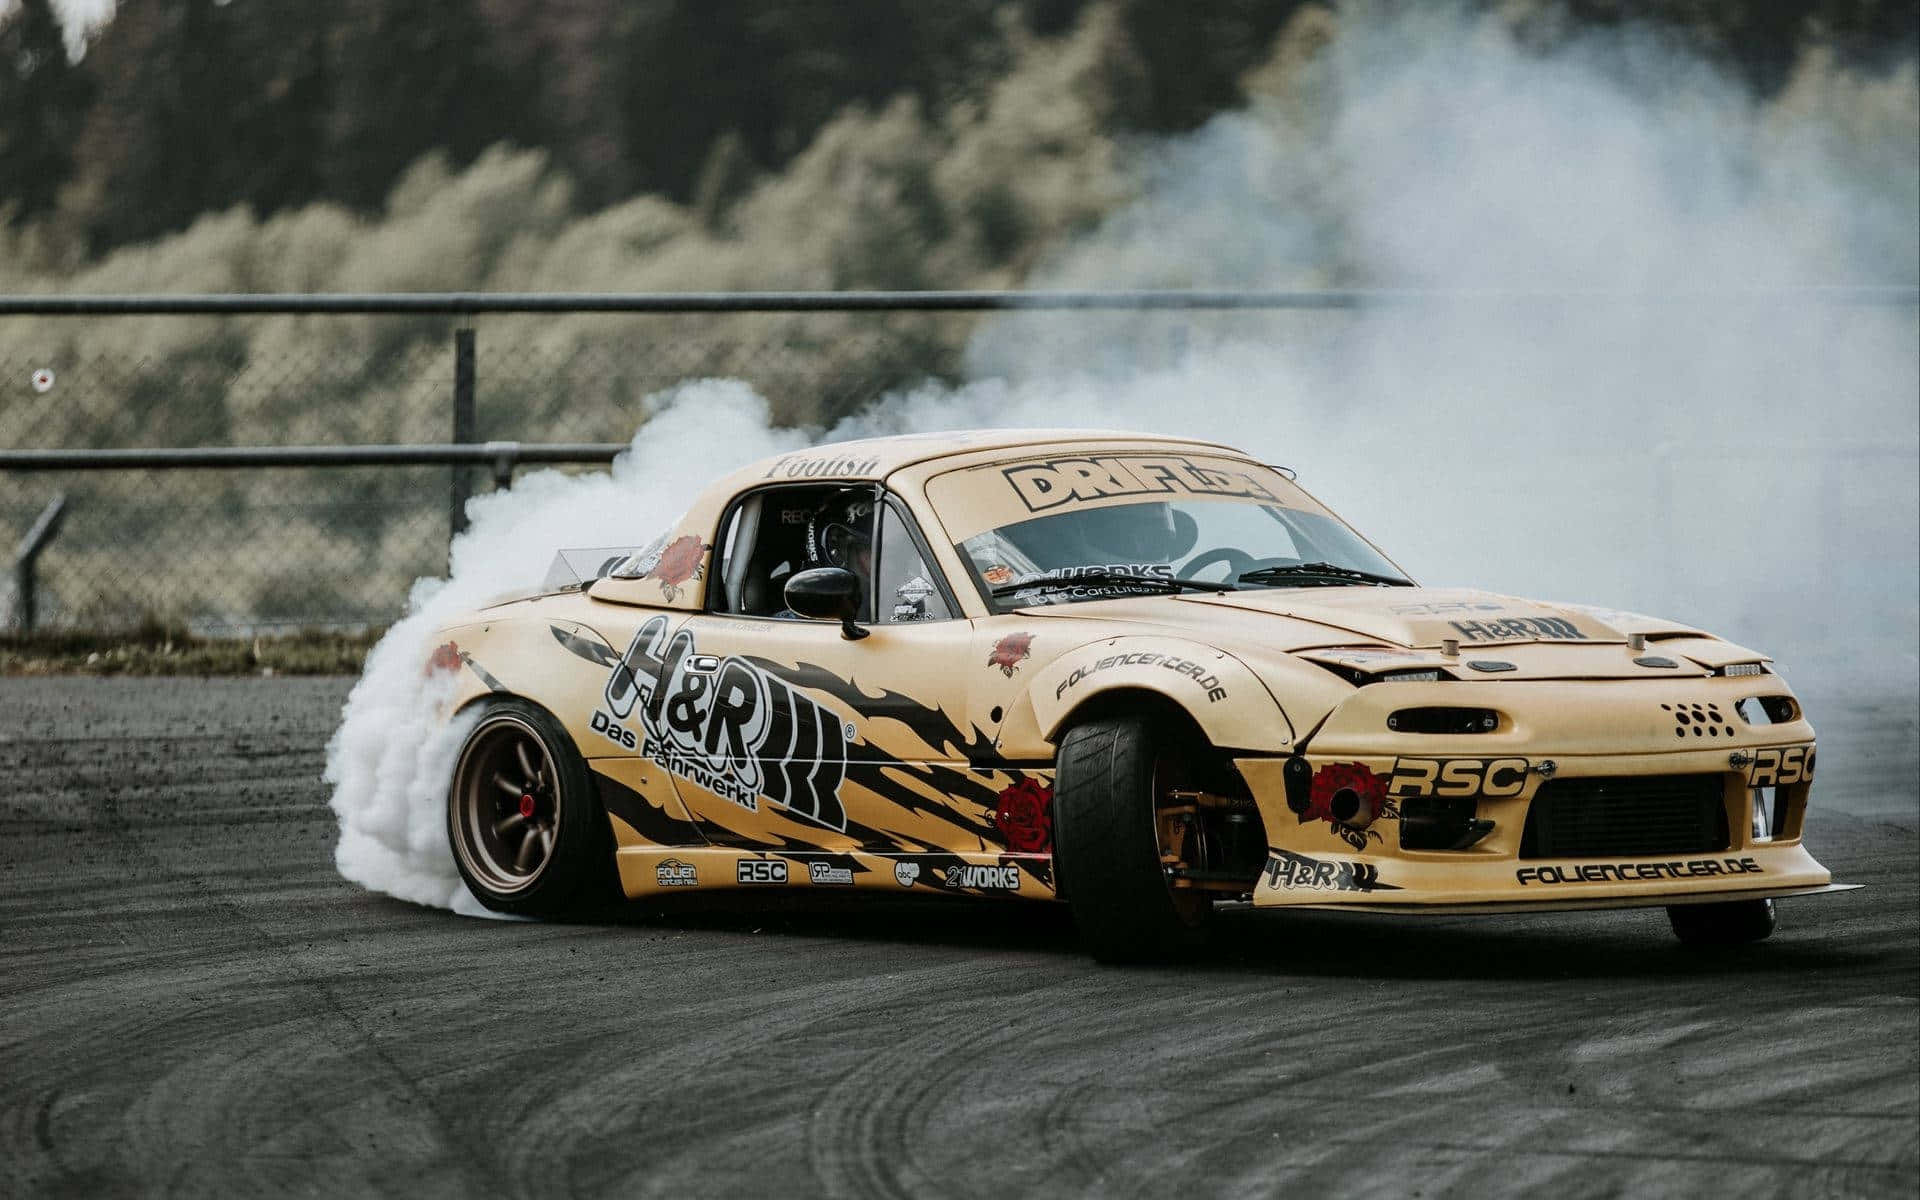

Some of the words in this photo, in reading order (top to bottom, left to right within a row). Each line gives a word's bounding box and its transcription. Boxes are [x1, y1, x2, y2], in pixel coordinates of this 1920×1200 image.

[591, 710, 636, 749] Das
[1389, 758, 1528, 797] RSC
[739, 863, 786, 881] RSC
[946, 866, 1018, 888] 21WORKS
[1269, 860, 1338, 890] H&R
